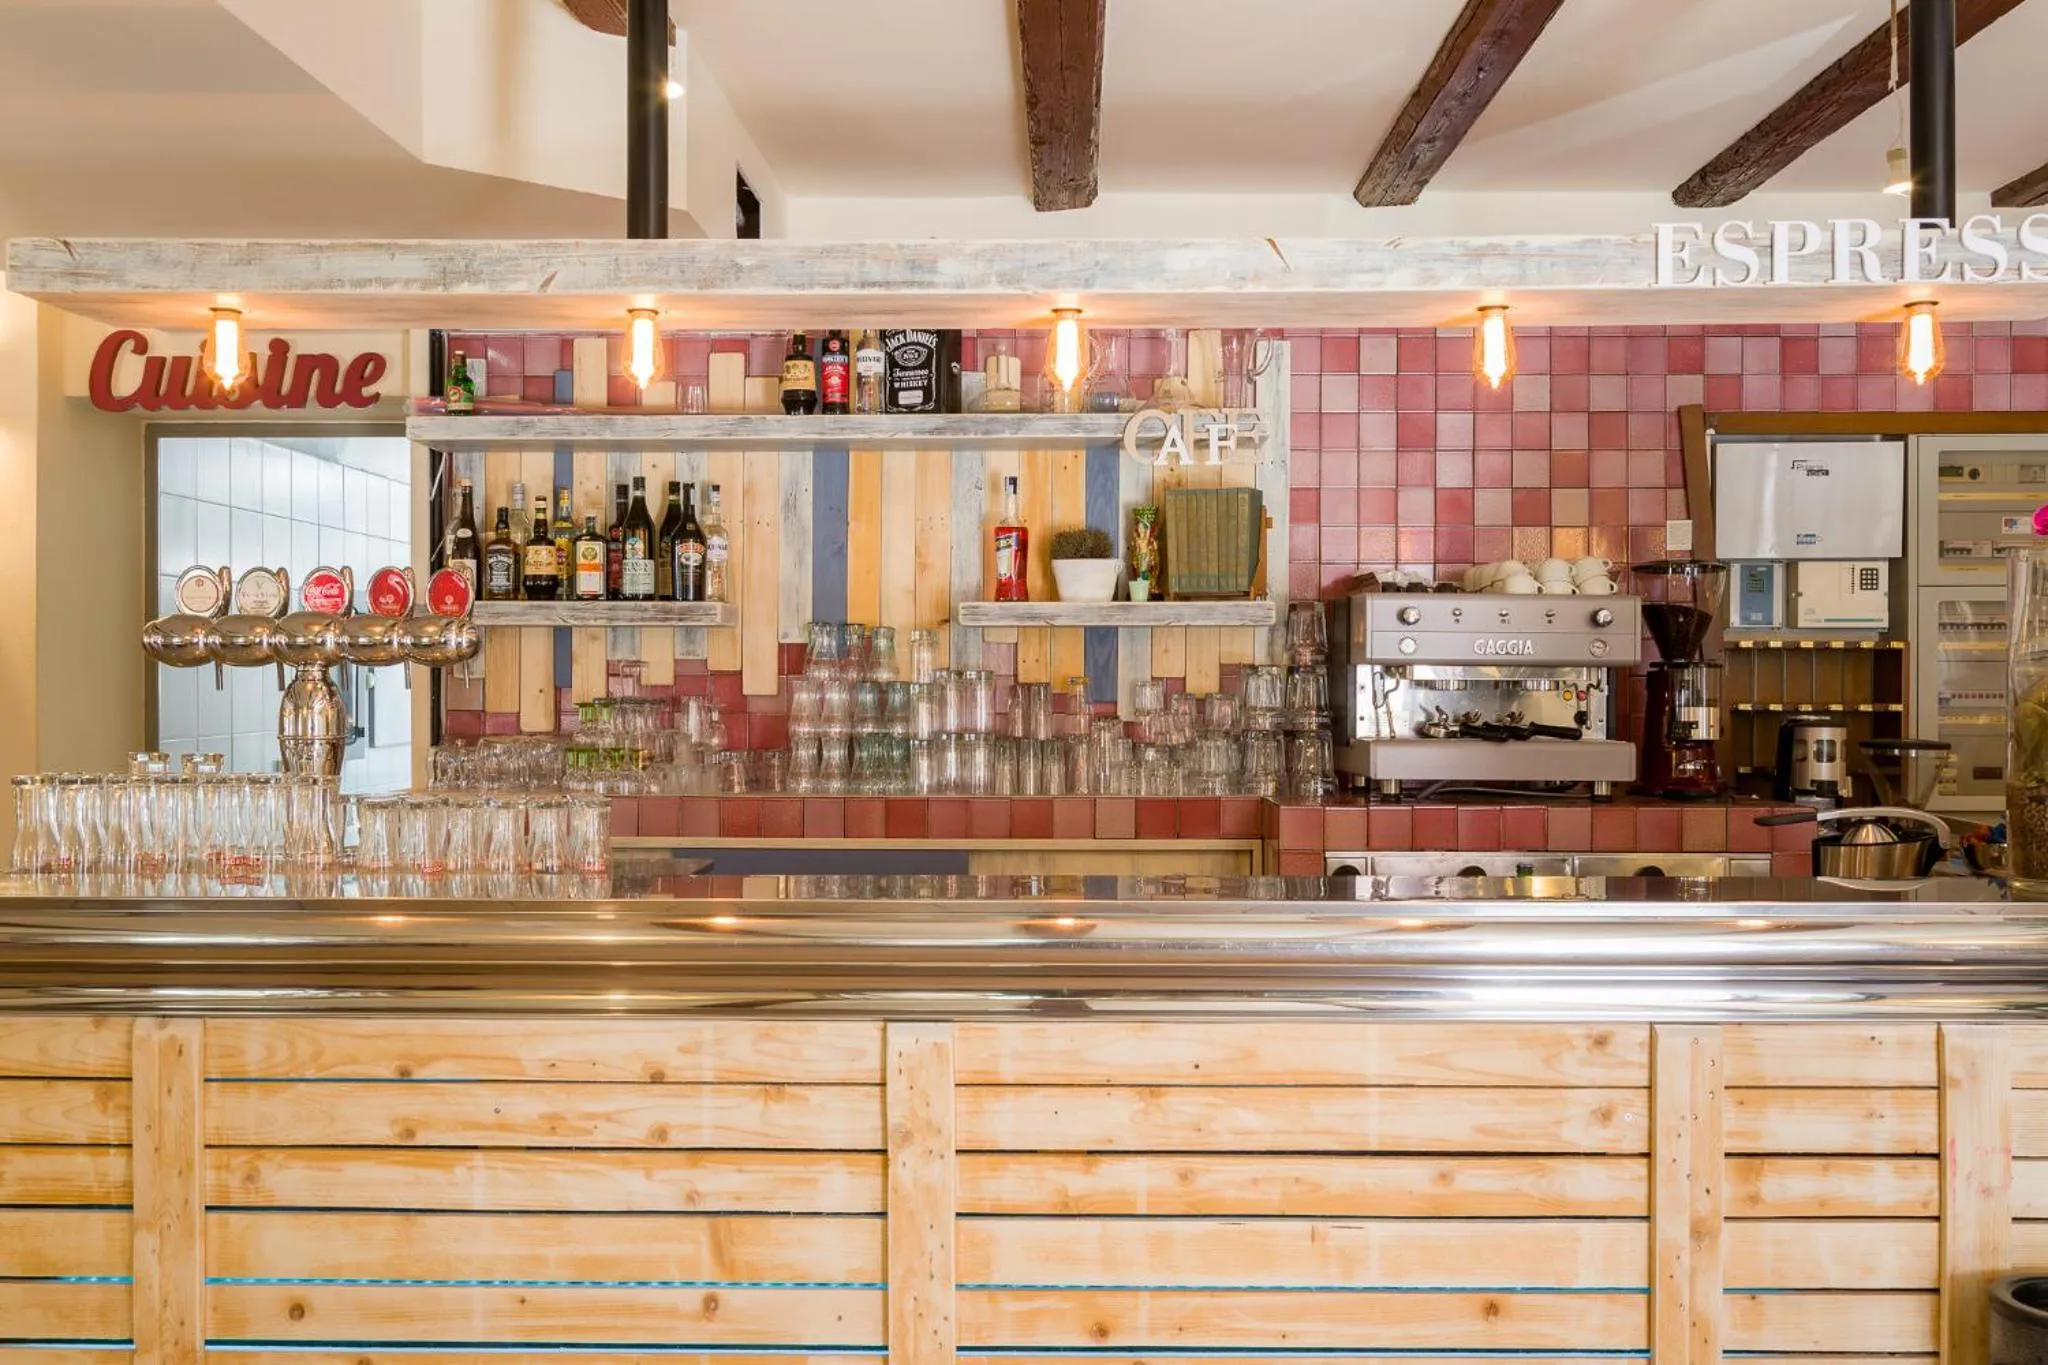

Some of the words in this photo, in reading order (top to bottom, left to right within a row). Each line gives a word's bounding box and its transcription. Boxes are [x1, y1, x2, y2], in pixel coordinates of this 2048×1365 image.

[1650, 213, 2048, 288] ESPRESS
[886, 332, 906, 352] JACK
[894, 379, 928, 388] WHISKEY
[1474, 638, 1534, 656] GAGGIA
